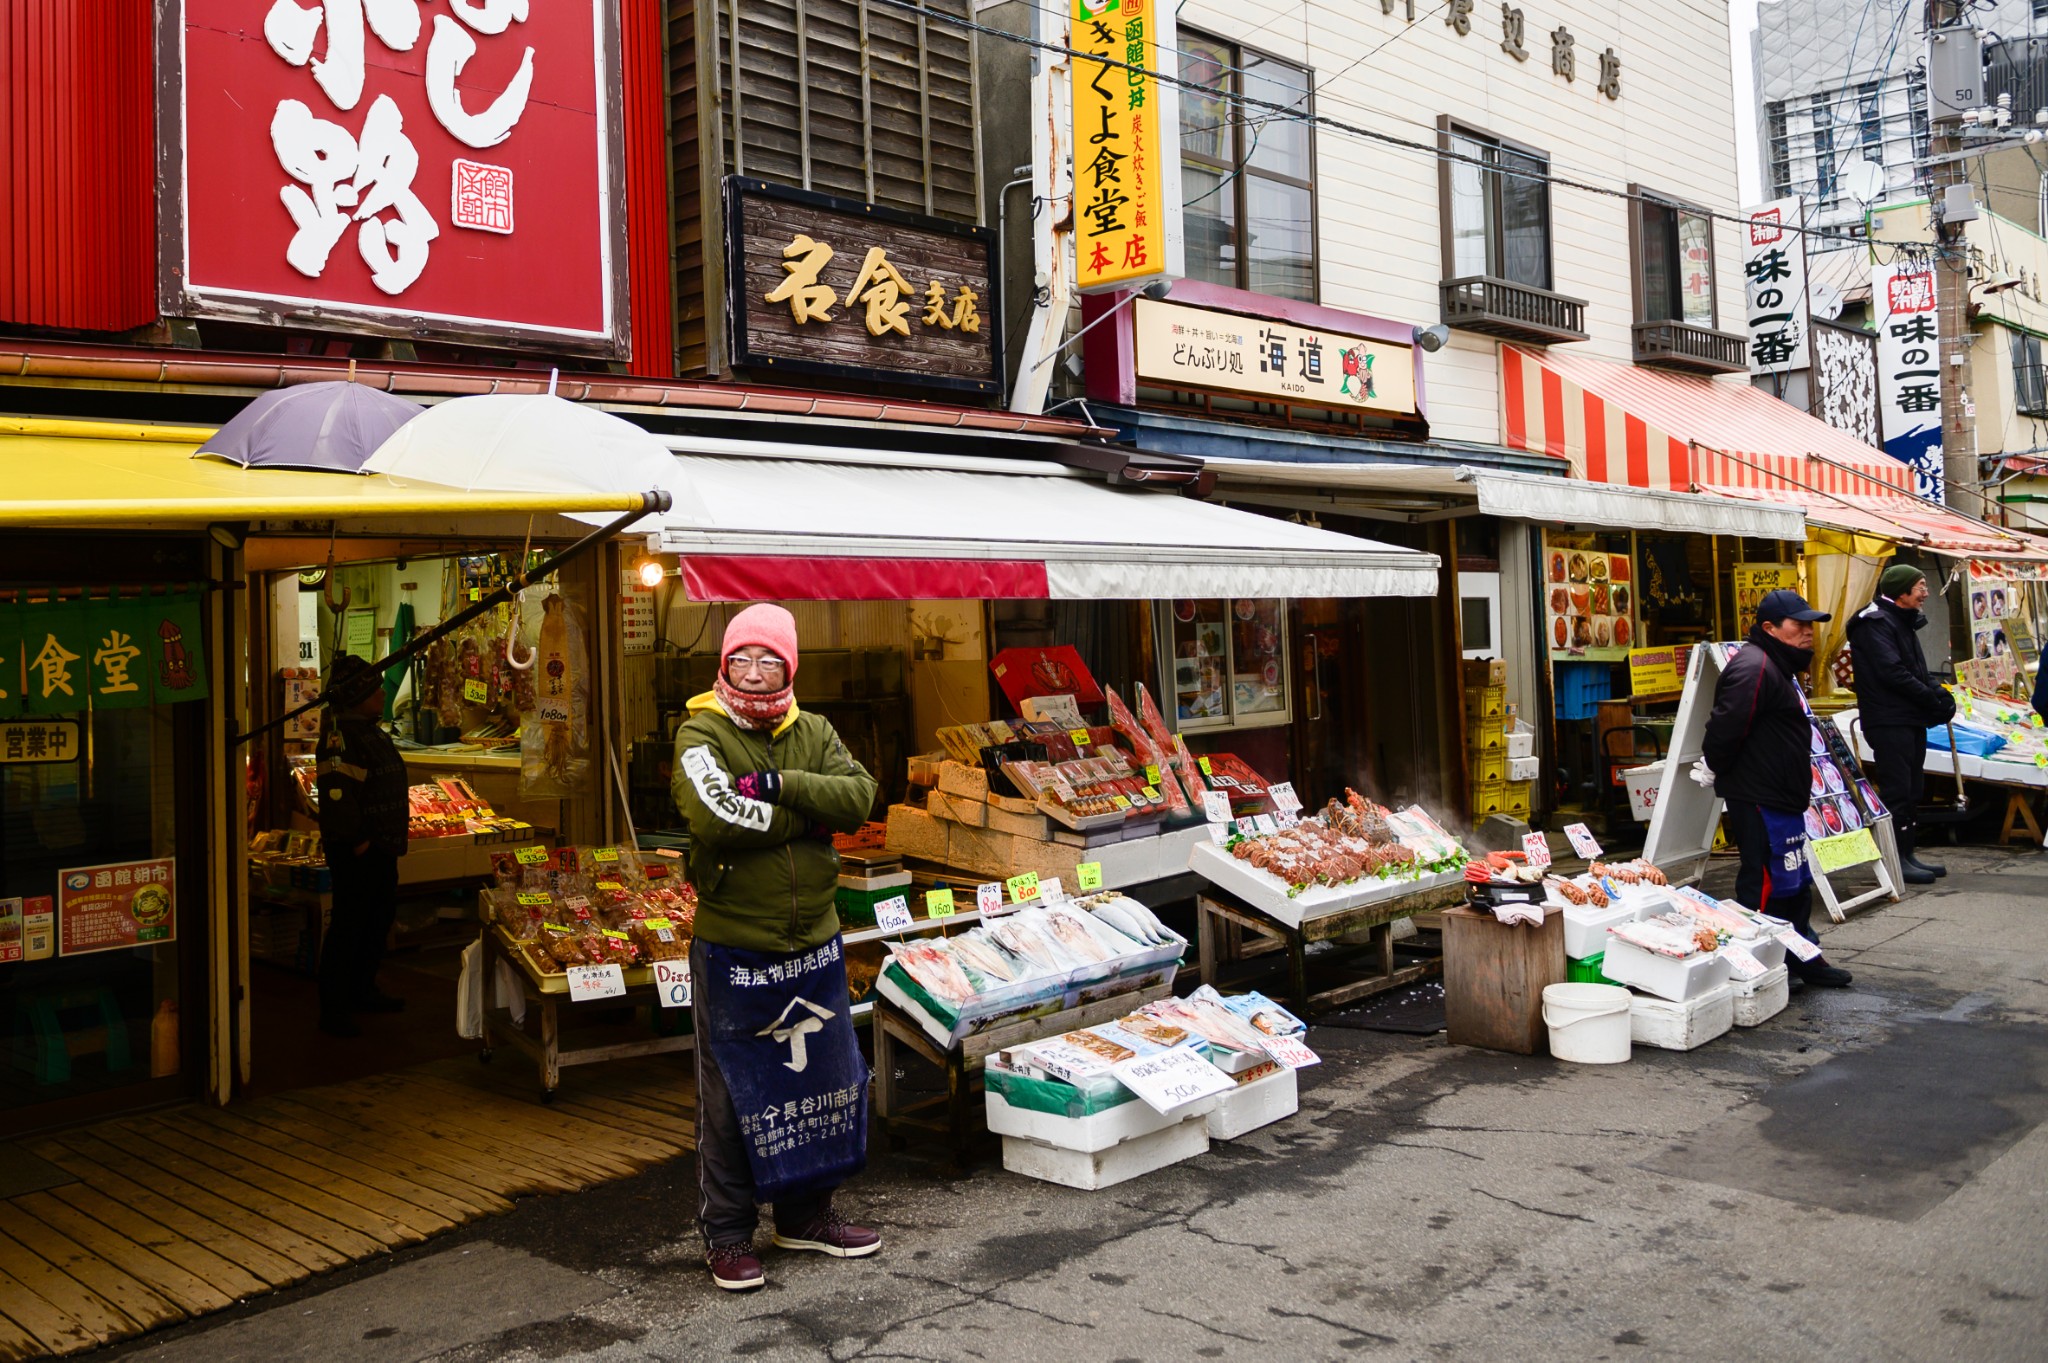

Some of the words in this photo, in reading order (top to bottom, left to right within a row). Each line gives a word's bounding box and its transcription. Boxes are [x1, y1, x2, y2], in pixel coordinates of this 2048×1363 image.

[1955, 88, 1973, 102] 50
[1082, 20, 1130, 238] きくよ食堂
[1132, 114, 1148, 228] 炭火炊きご飯
[1086, 233, 1148, 276] 本店
[1744, 248, 1795, 366] 味の一番
[1172, 342, 1244, 375] どんぶり処
[1259, 327, 1325, 384] 海道
[1890, 314, 1940, 414] 味の一番
[1281, 382, 1305, 393] KAIDO
[0, 629, 141, 699] 食堂
[299, 641, 314, 659] 31
[5, 725, 67, 758] 営業中
[94, 865, 168, 888] 函館朝市
[784, 1082, 859, 1121] 長谷川商店
